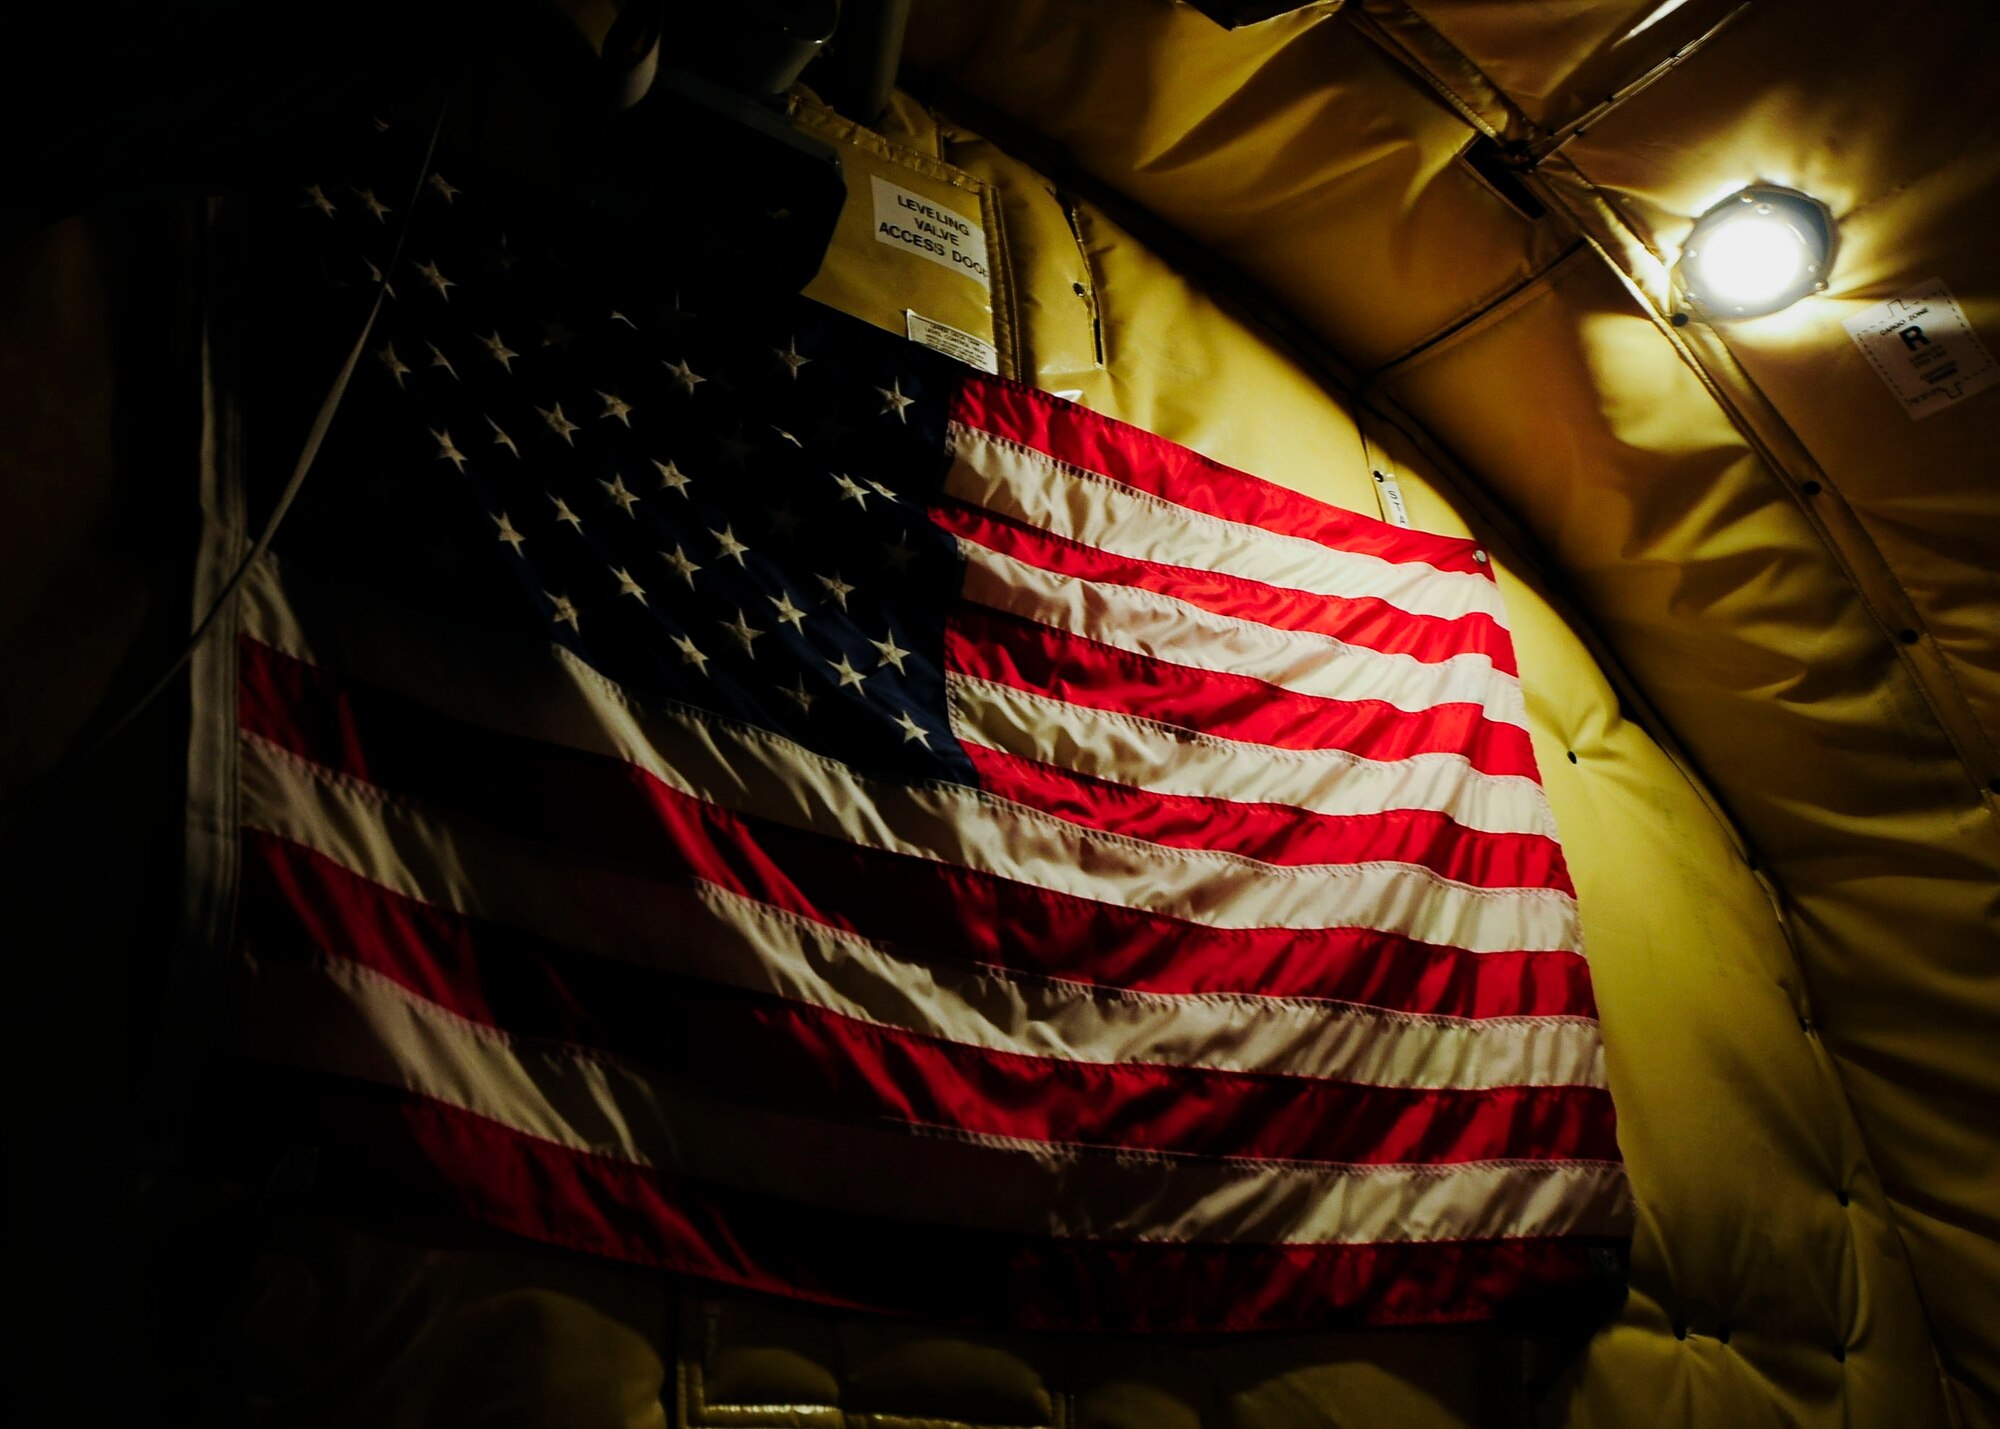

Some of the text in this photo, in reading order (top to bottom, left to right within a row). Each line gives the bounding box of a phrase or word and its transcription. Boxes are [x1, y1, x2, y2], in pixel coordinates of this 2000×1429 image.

[897, 194, 970, 236] LEVELING
[879, 221, 945, 257] ACCESS
[914, 217, 960, 247] VALVE
[1909, 306, 1929, 321] ZONE
[1899, 325, 1930, 351] R
